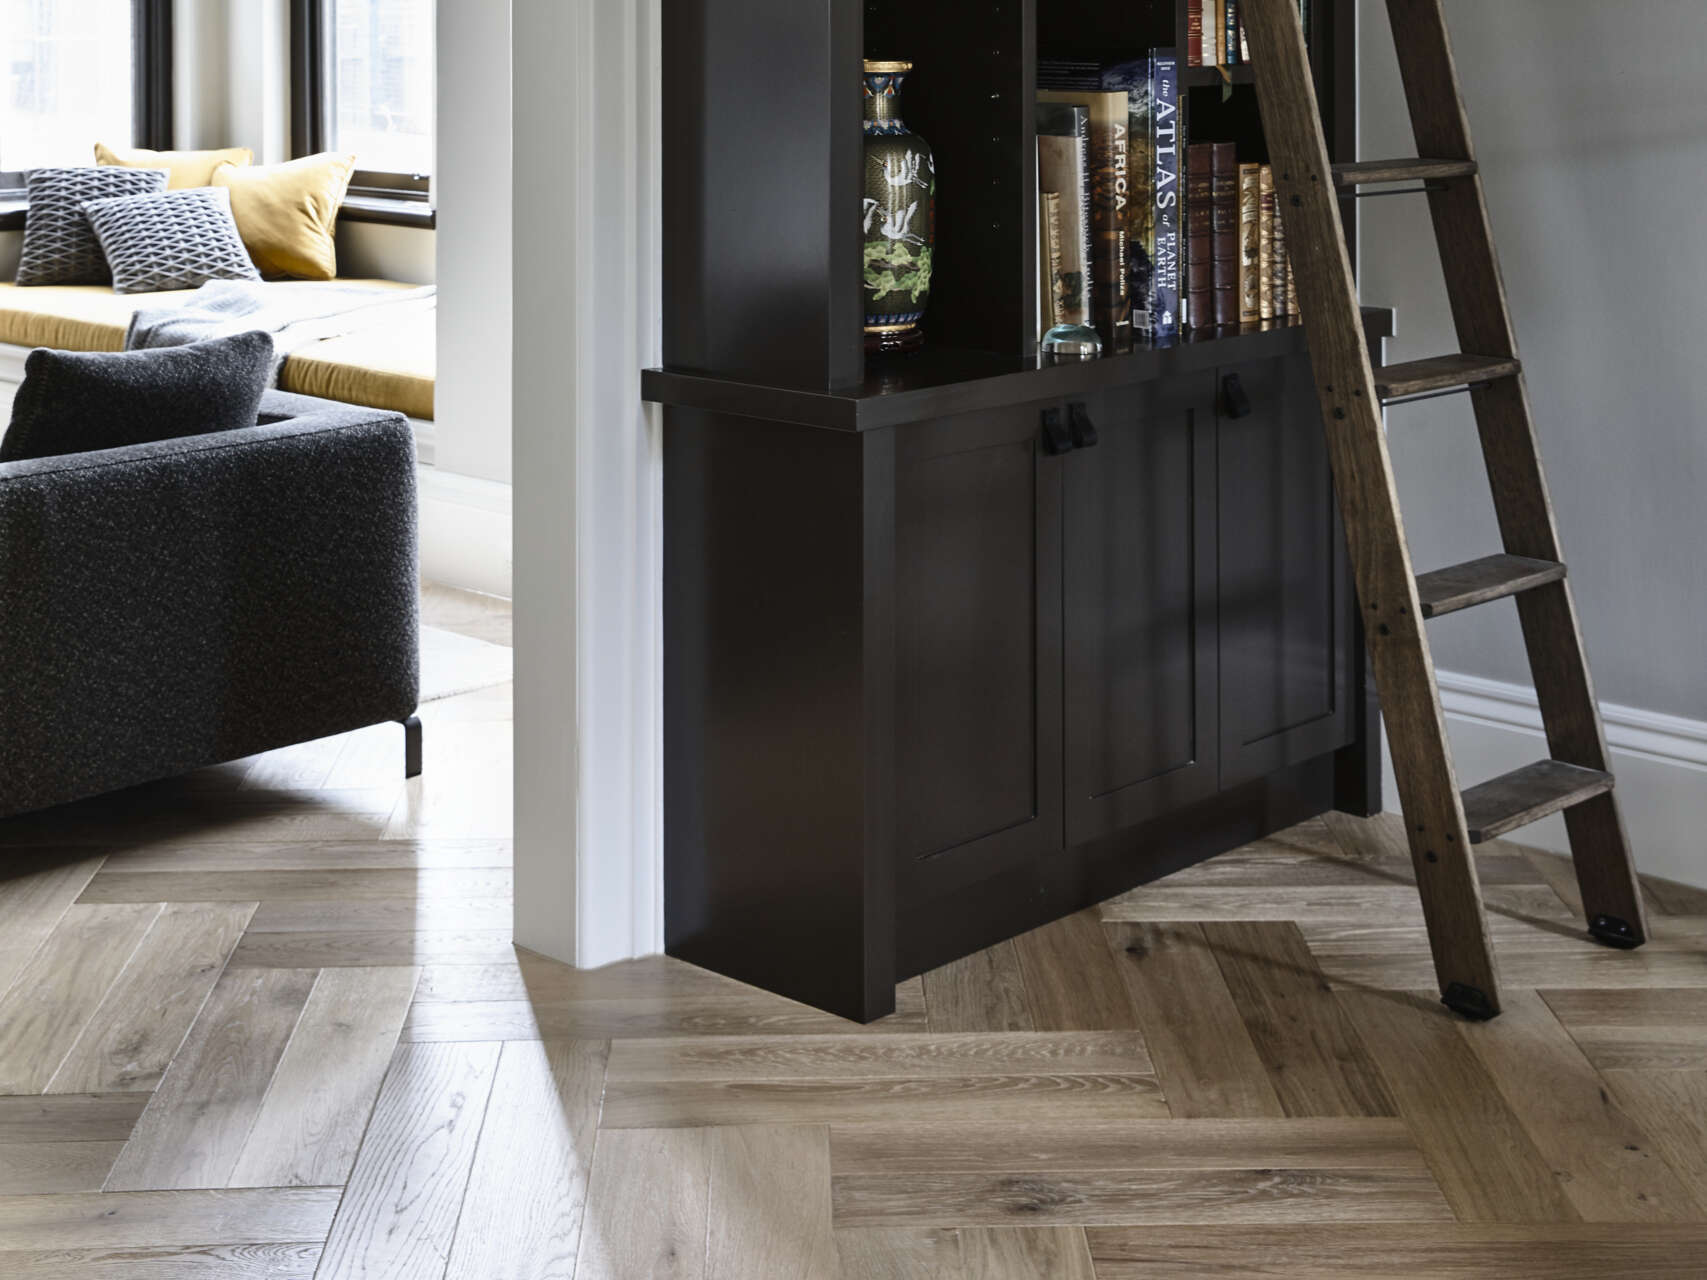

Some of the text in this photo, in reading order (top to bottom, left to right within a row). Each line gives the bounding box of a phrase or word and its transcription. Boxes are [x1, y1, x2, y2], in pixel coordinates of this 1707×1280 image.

[1162, 79, 1171, 97] the
[1114, 123, 1127, 211] AFRICA
[1156, 98, 1176, 209] ATLAS
[1162, 214, 1171, 228] of
[1157, 237, 1166, 288] EARTH
[1167, 232, 1176, 291] PLANET
